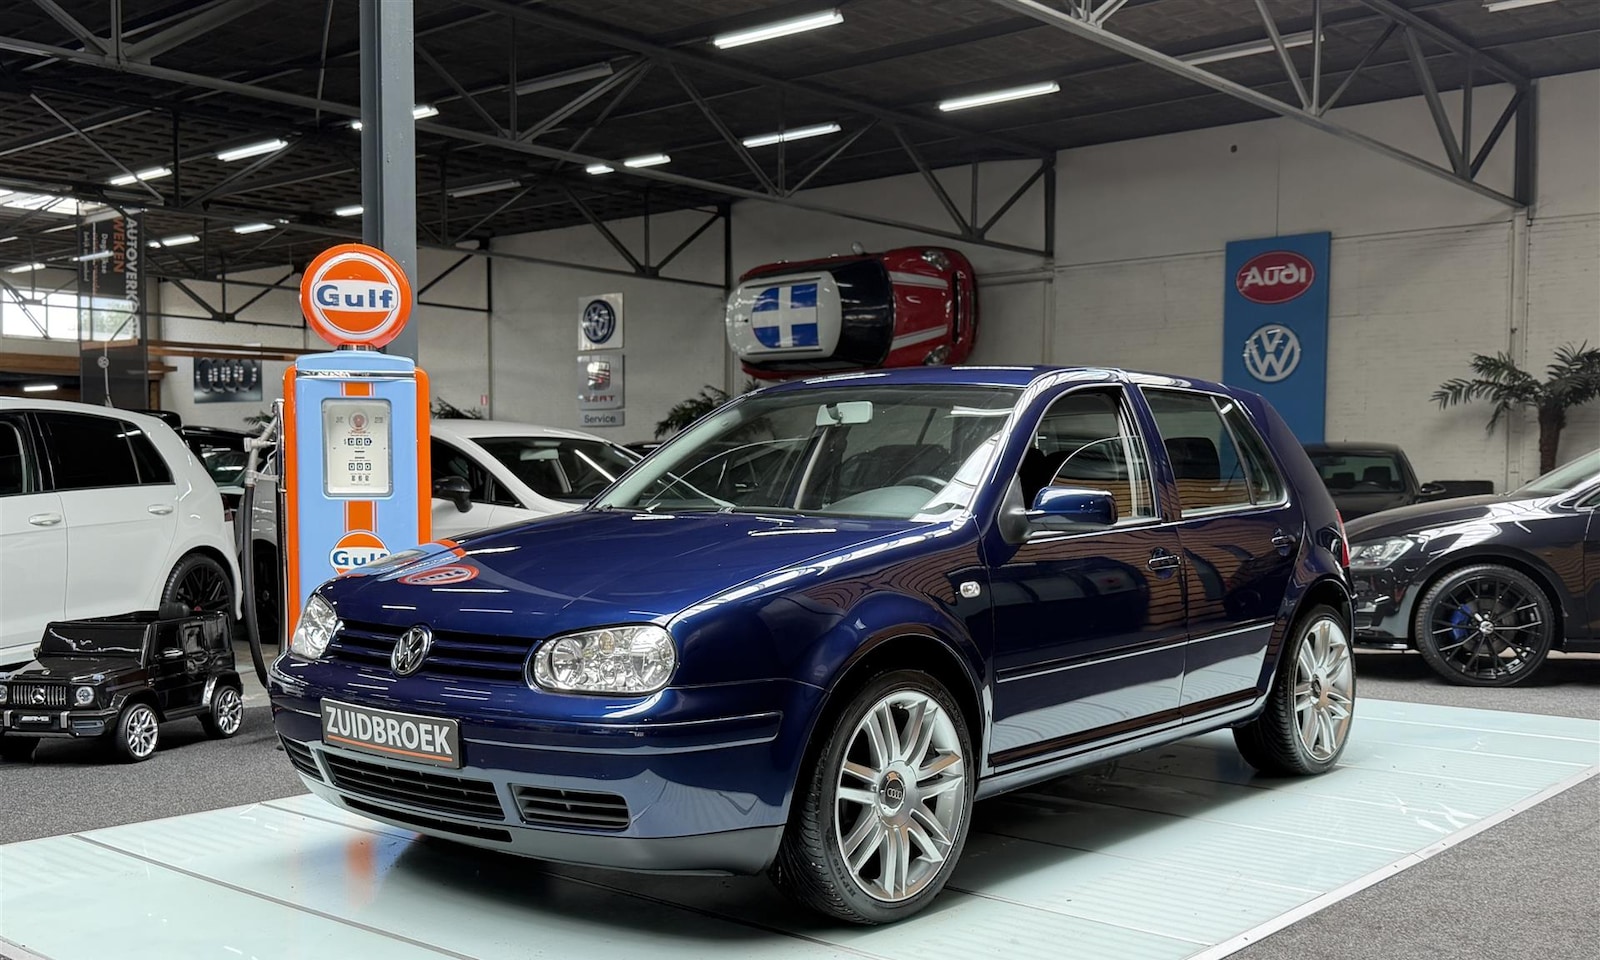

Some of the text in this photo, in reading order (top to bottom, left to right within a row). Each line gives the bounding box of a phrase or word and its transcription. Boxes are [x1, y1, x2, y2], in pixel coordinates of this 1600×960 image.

[112, 216, 125, 273] WEKEN
[316, 284, 393, 309] Gulf
[584, 414, 616, 424] Service
[325, 706, 453, 755] ZUIDBROEK
